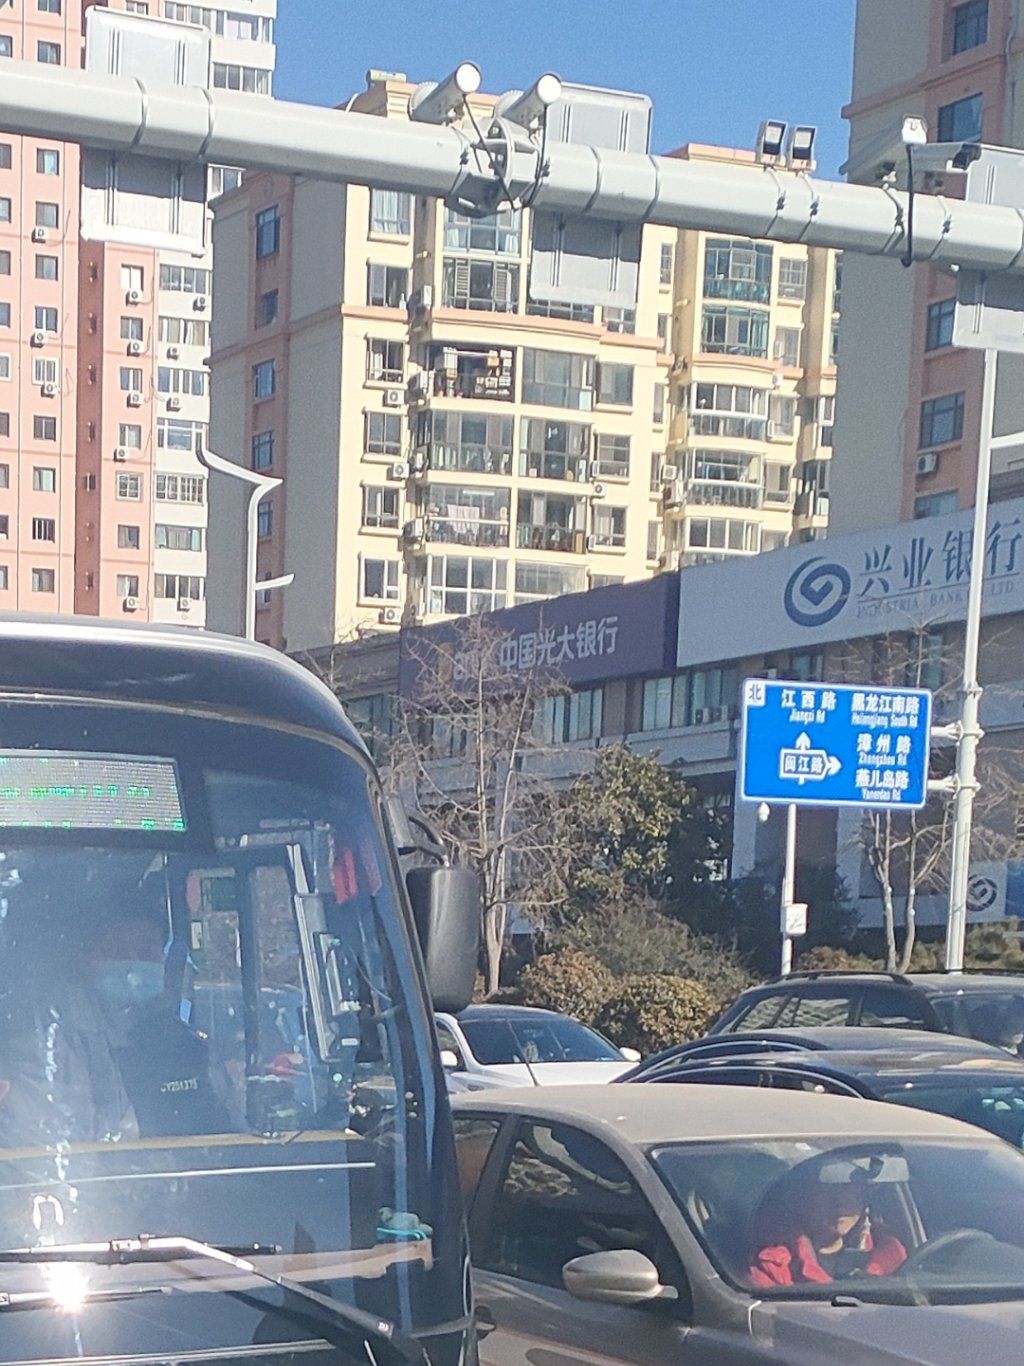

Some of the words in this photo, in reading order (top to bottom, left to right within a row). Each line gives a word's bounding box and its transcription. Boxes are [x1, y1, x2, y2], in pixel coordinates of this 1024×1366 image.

[859, 518, 1022, 597] 兴业银行
[857, 598, 924, 619] INDUSTRIA
[500, 616, 618, 670] 中国光大银行
[749, 684, 761, 701] 北
[781, 689, 836, 710] 江西路
[851, 693, 919, 714] 黑龙江南路
[817, 710, 826, 723] Rd
[857, 733, 911, 754] 漳州路
[785, 756, 824, 774] 闽江路
[855, 769, 909, 790] 燕儿岛路
